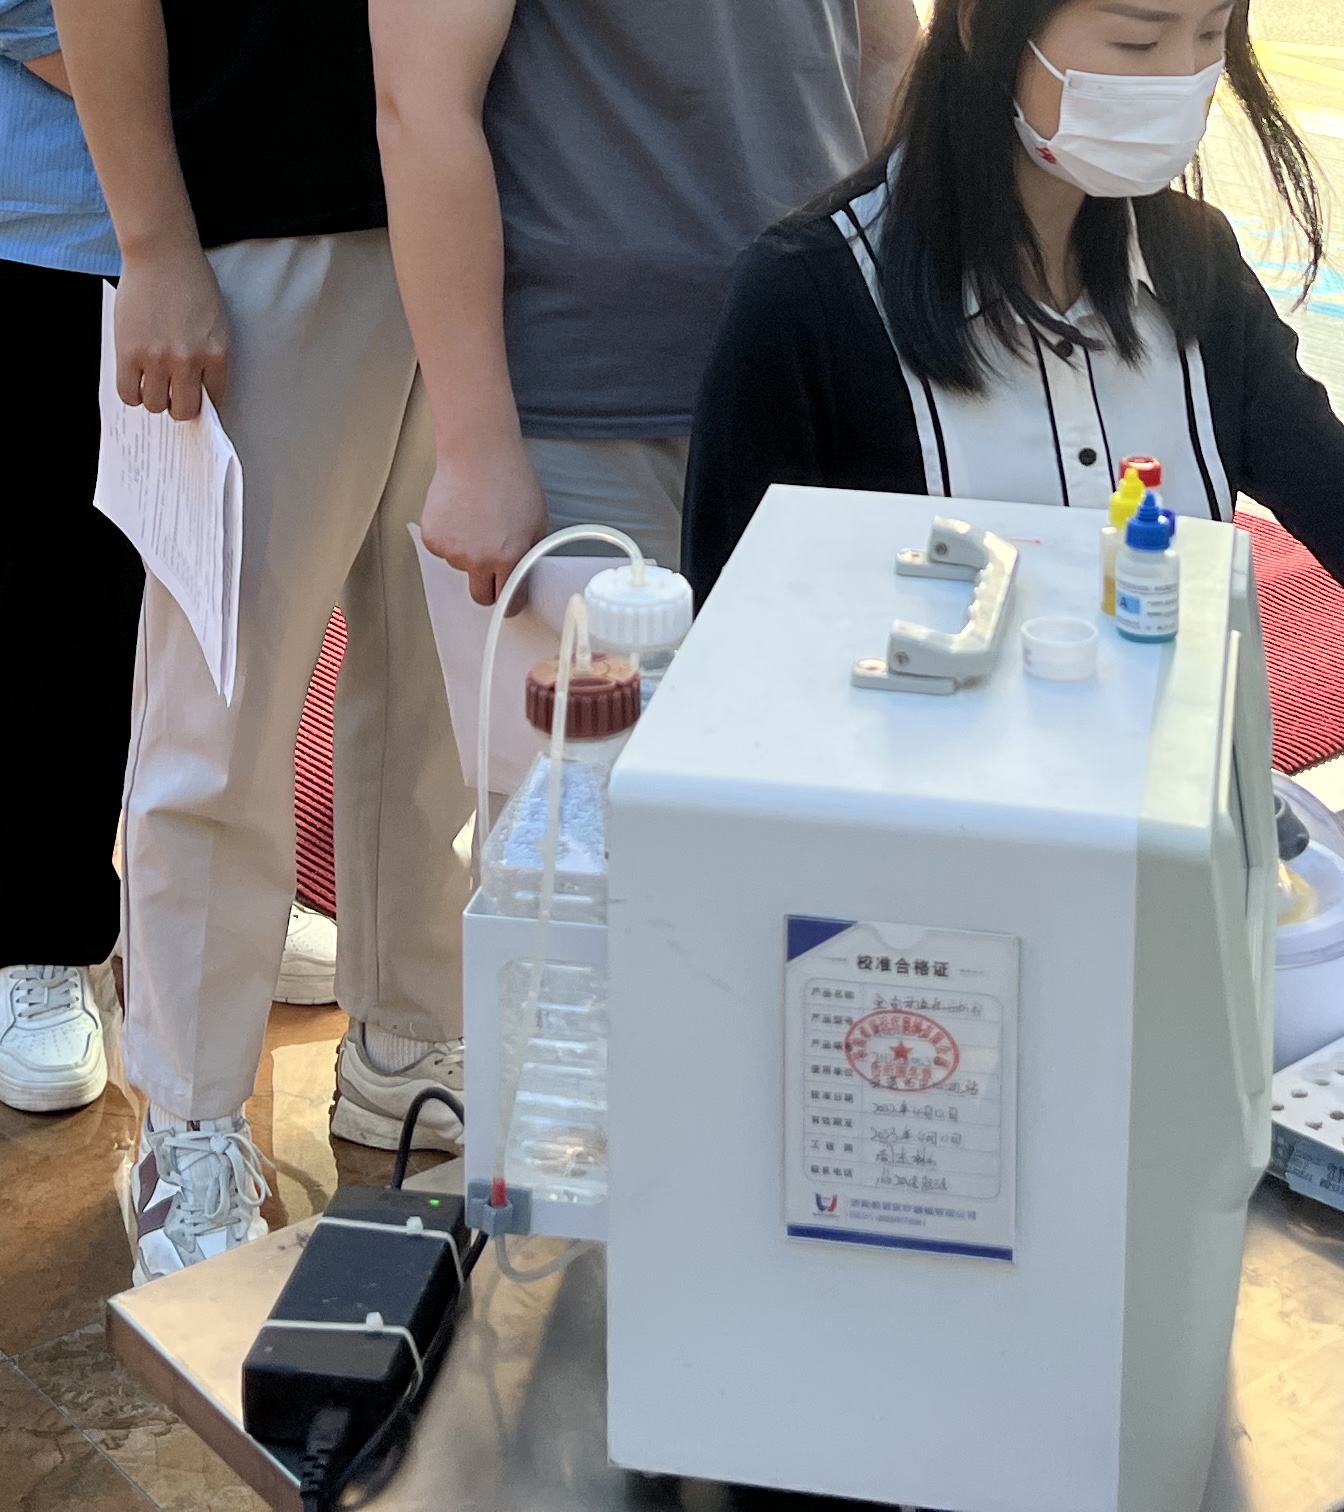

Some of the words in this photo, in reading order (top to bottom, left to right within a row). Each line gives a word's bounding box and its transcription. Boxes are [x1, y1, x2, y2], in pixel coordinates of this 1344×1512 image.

[857, 955, 950, 977] 校准合格证
